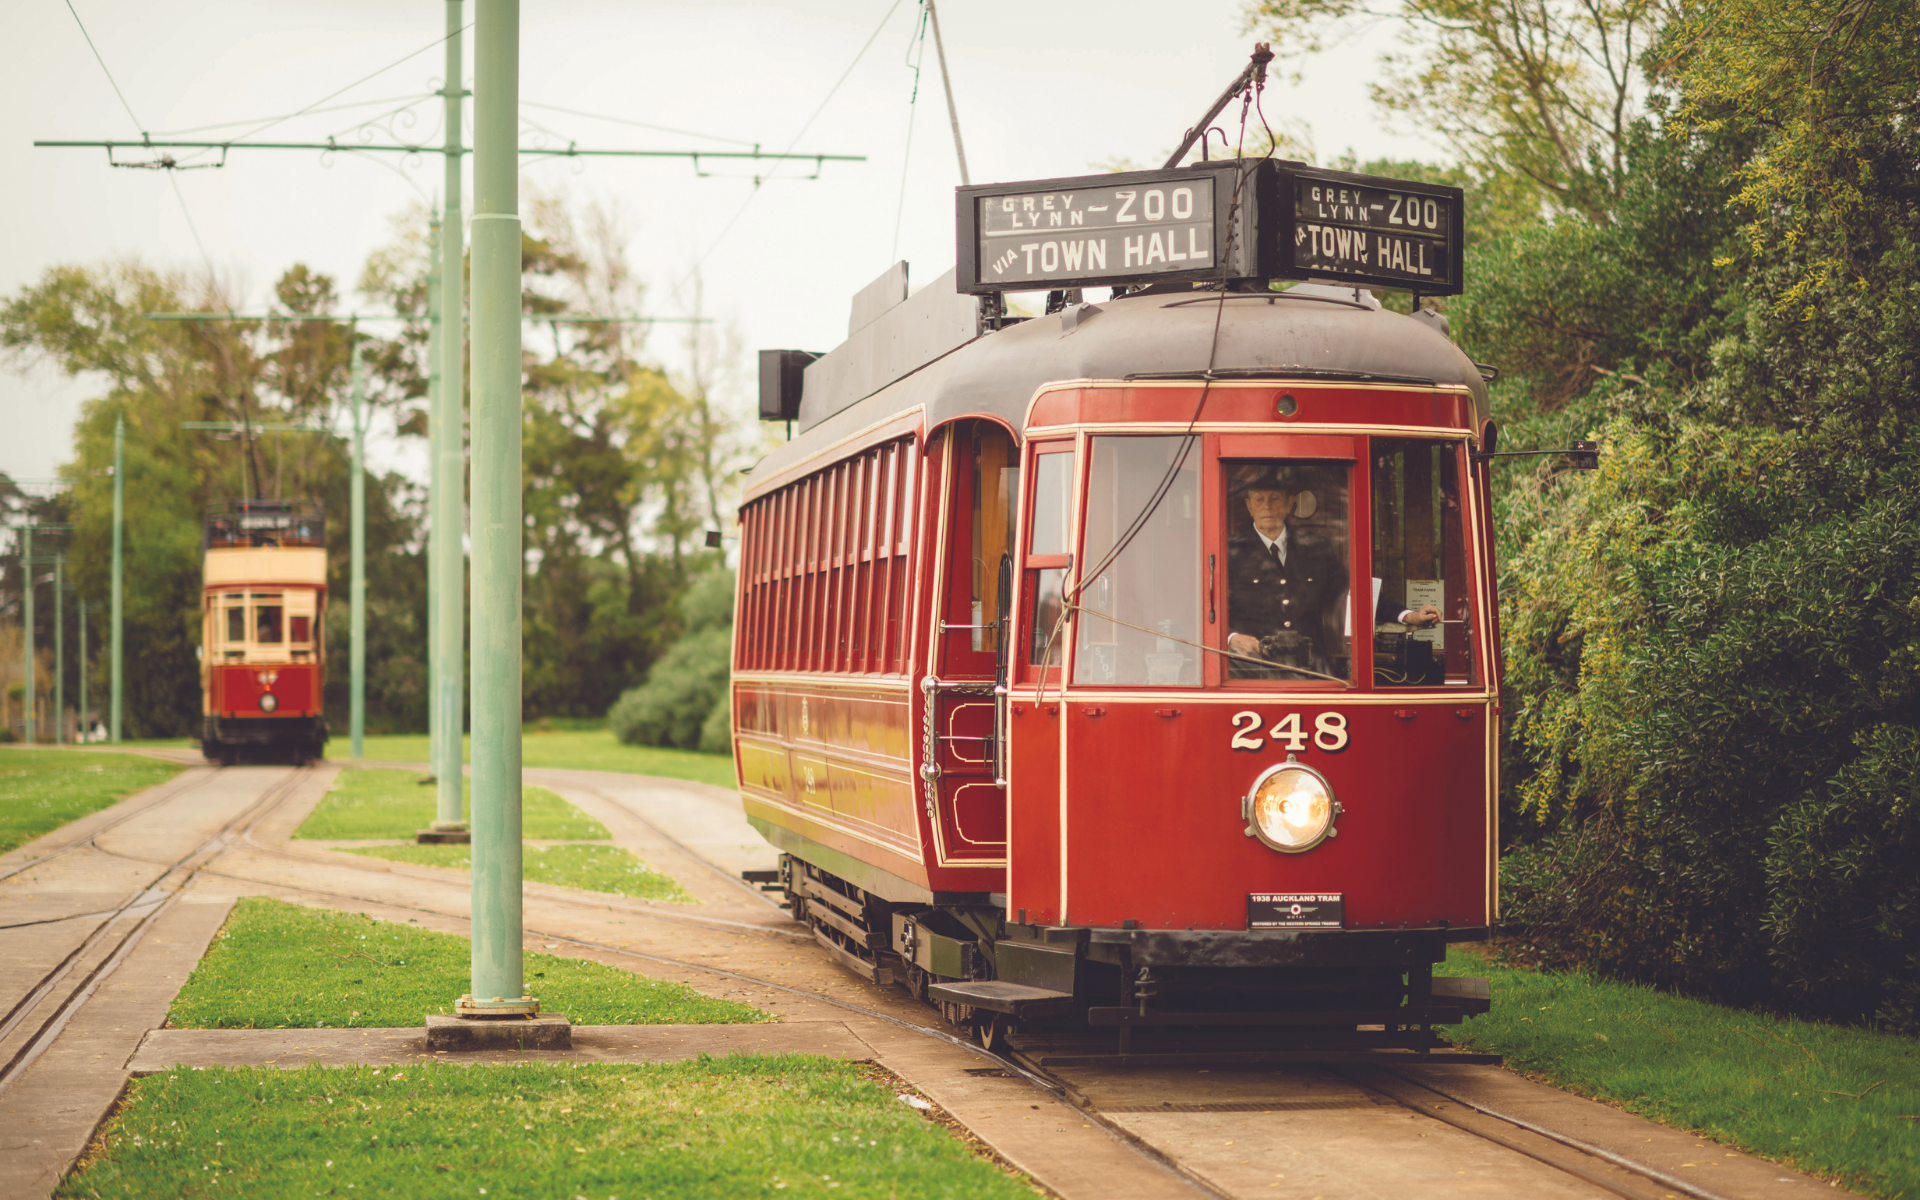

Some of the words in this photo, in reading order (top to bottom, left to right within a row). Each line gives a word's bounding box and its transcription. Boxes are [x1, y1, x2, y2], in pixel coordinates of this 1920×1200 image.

[1002, 194, 1074, 212] GREY
[1310, 186, 1362, 205] GREY
[1011, 210, 1084, 228] LYNN
[1318, 203, 1369, 222] LYNN
[992, 248, 1019, 276] VIA
[1020, 238, 1107, 275] TOWN
[1124, 227, 1209, 268] HALL
[1307, 224, 1369, 265] TOWN
[1377, 235, 1432, 276] HALL
[1094, 646, 1113, 681] STOP
[1230, 710, 1349, 751] 248
